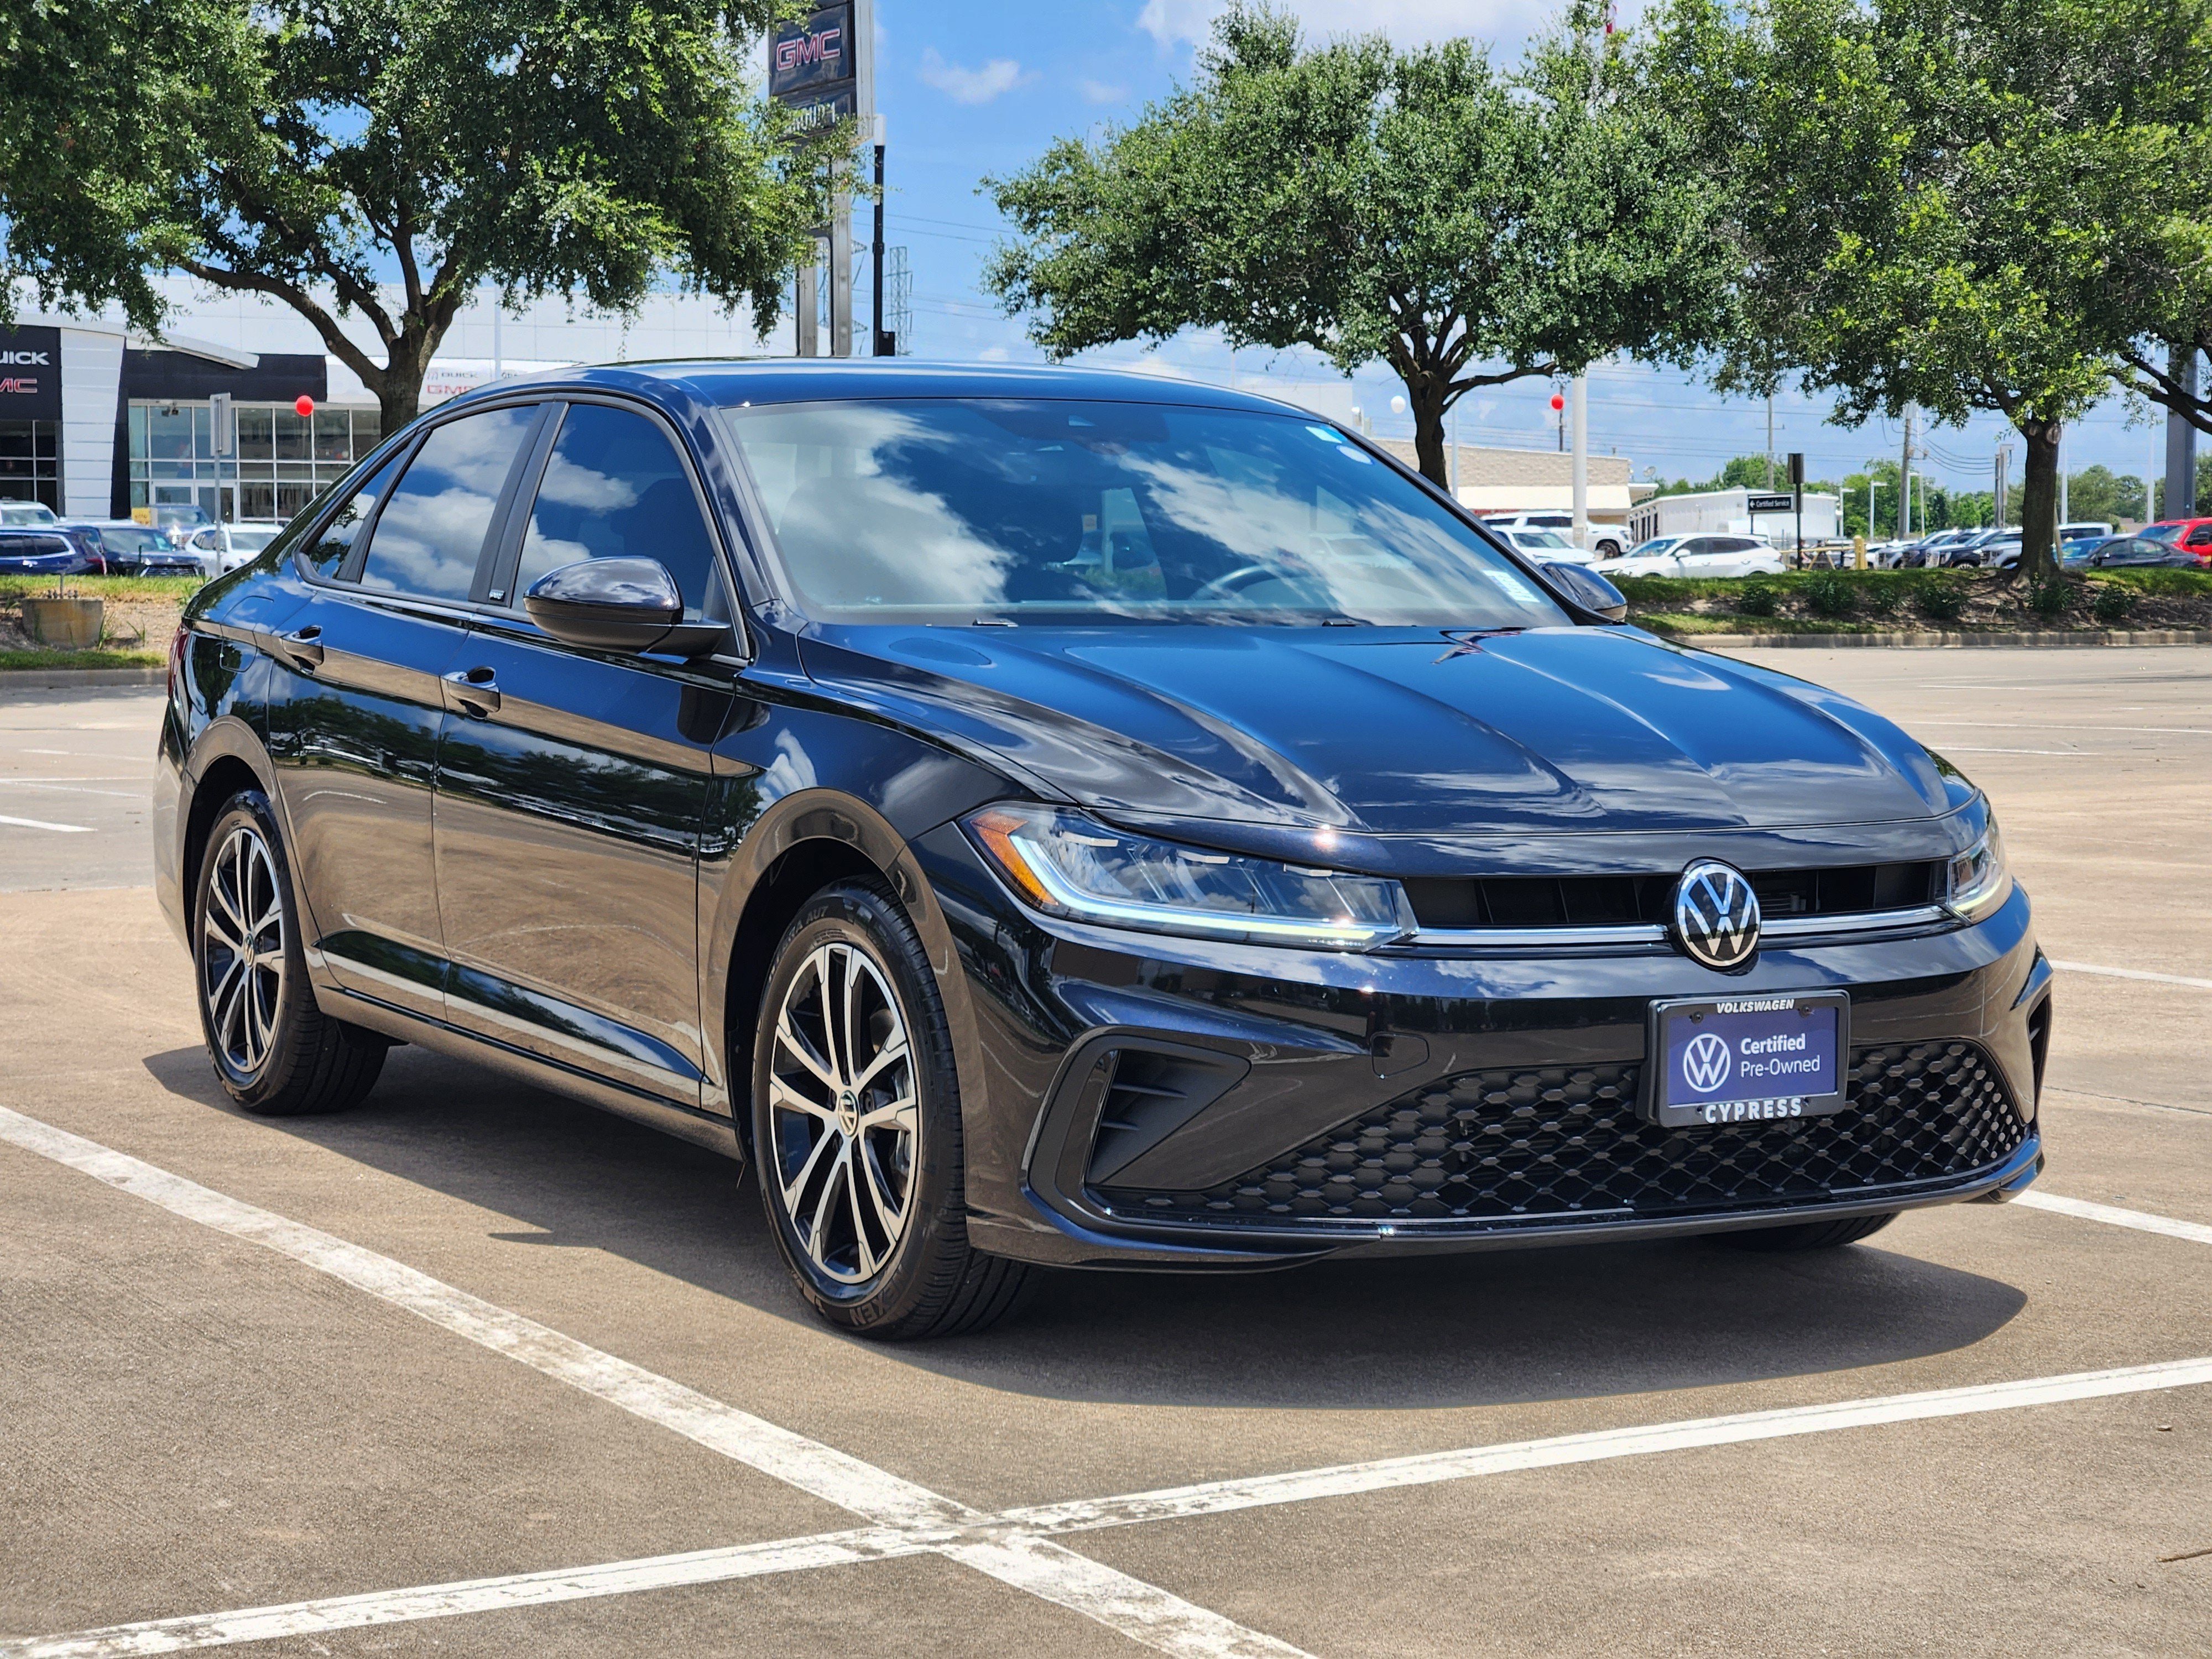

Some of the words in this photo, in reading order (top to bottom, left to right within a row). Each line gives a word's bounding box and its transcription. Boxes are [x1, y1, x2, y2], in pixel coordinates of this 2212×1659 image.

[776, 28, 841, 71] GMC
[1756, 499, 1773, 508] Certified
[1717, 999, 1795, 1014] VOLKSWAGEN
[1740, 1032, 1806, 1055] Certified
[1740, 1054, 1820, 1078] Pre-Owned
[1705, 1098, 1802, 1124] CYPRESS
